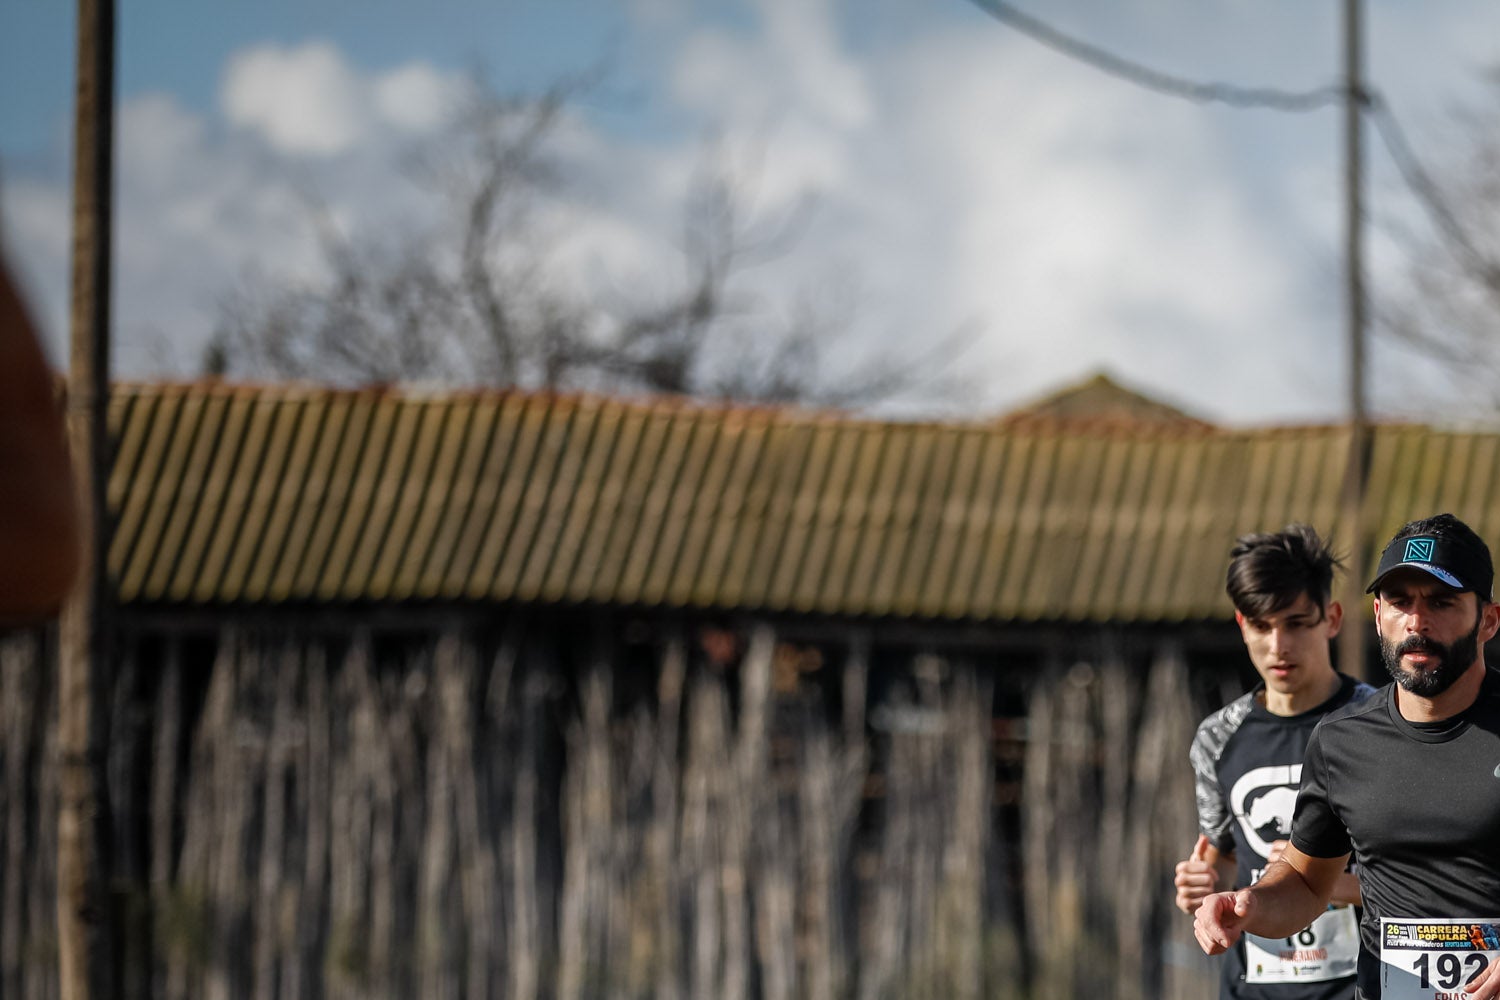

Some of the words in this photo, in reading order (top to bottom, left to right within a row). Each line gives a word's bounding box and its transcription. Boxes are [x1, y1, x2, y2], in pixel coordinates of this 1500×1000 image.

[1387, 925, 1399, 935] 26
[1417, 925, 1467, 934] CARRERA
[1418, 933, 1467, 941] POPULAR
[1413, 953, 1489, 989] 192
